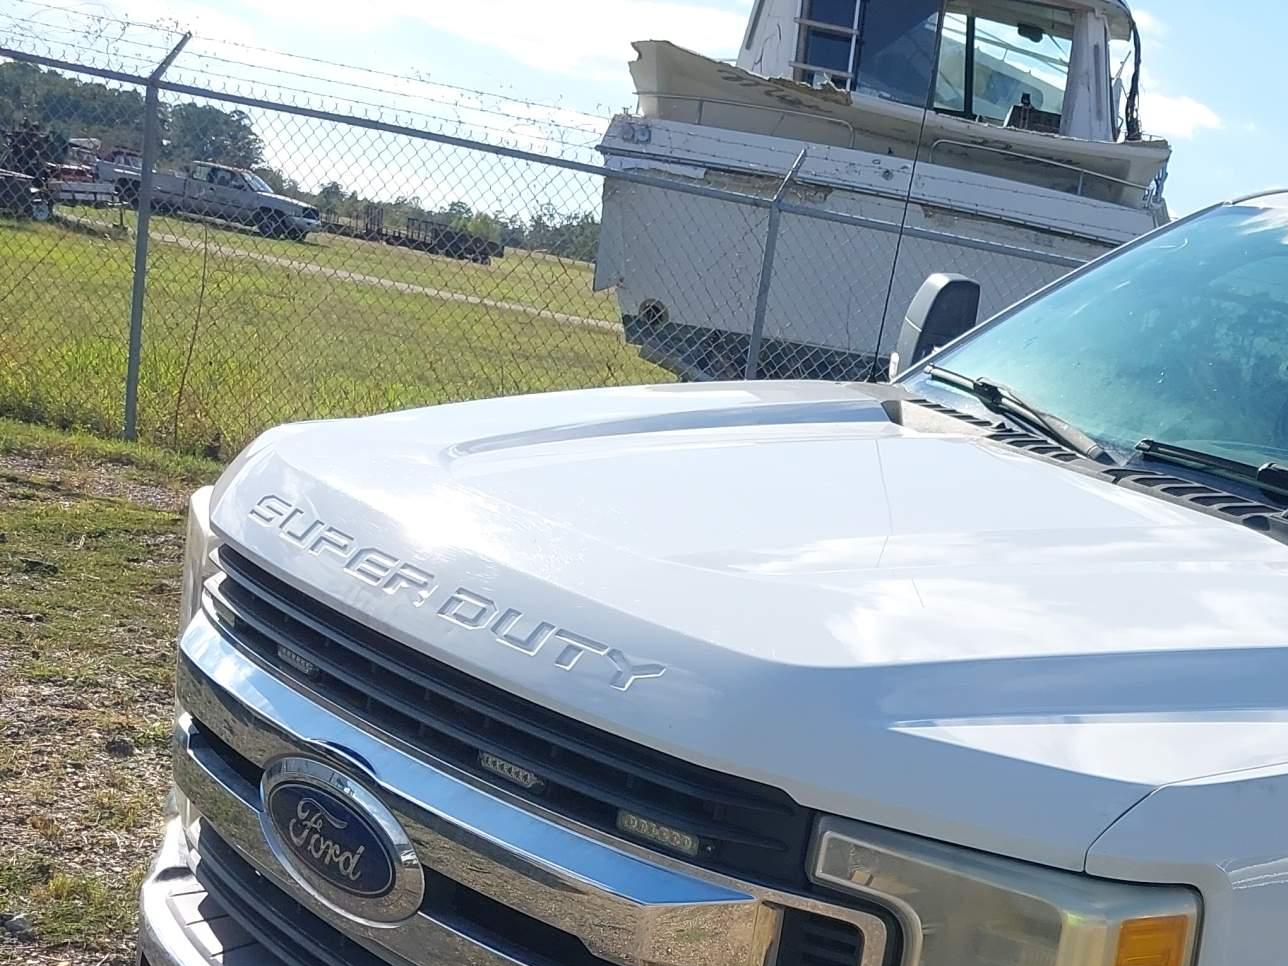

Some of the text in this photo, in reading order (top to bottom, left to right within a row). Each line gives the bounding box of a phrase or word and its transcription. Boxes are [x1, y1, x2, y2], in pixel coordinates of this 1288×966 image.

[247, 494, 668, 692] SUPER DUTY
[289, 797, 365, 881] Ford
